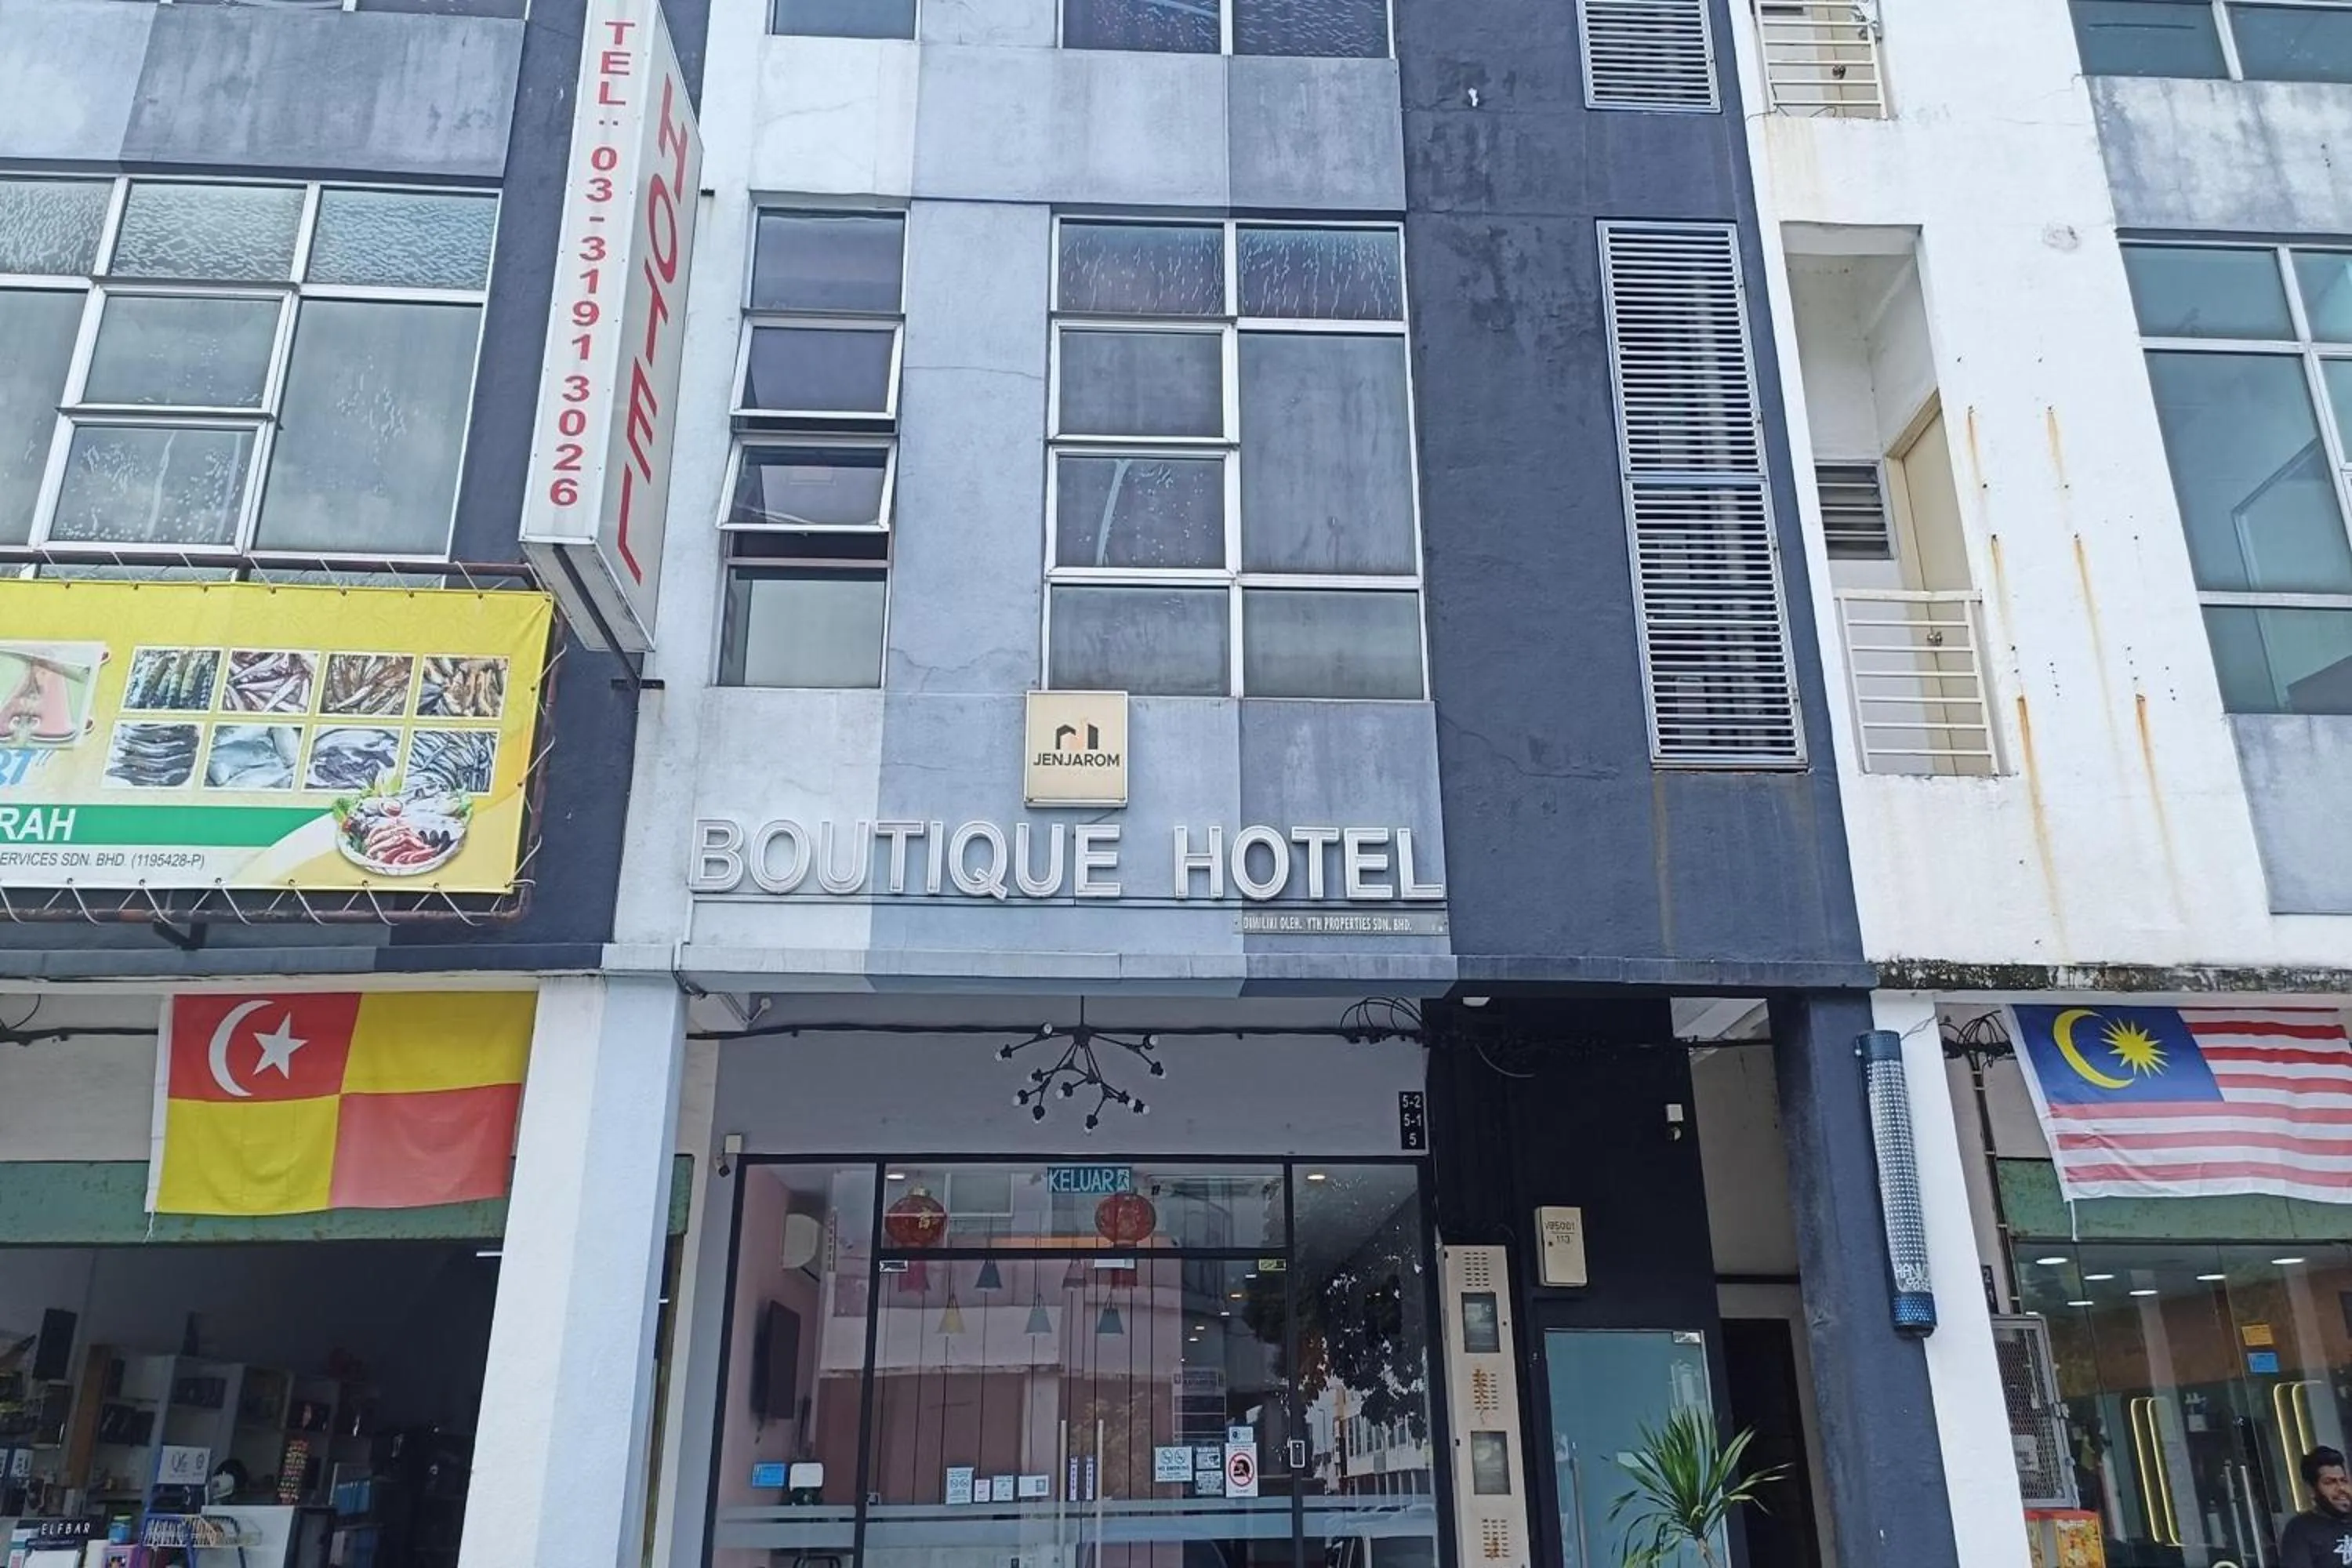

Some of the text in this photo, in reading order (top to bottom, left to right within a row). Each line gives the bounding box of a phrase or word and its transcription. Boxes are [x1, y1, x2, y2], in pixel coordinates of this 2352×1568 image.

[617, 72, 688, 586] HOTEL
[1033, 753, 1120, 767] JENJAROM
[0, 807, 77, 841] RAH
[60, 852, 91, 866] SDN.
[96, 853, 126, 866] BHD.
[131, 853, 205, 869] (1195428-P)
[689, 818, 1445, 902] BOUTIQUE HOTEL
[1324, 916, 1371, 931] PROPERTIES
[1373, 917, 1392, 931] SDN.
[1393, 918, 1412, 931] BHD.
[1403, 1094, 1421, 1108] 5-2
[1404, 1113, 1421, 1127] 5-1
[1409, 1133, 1417, 1146] 5
[1048, 1169, 1114, 1192] KELUAR
[41, 1523, 91, 1536] ELFBAR
